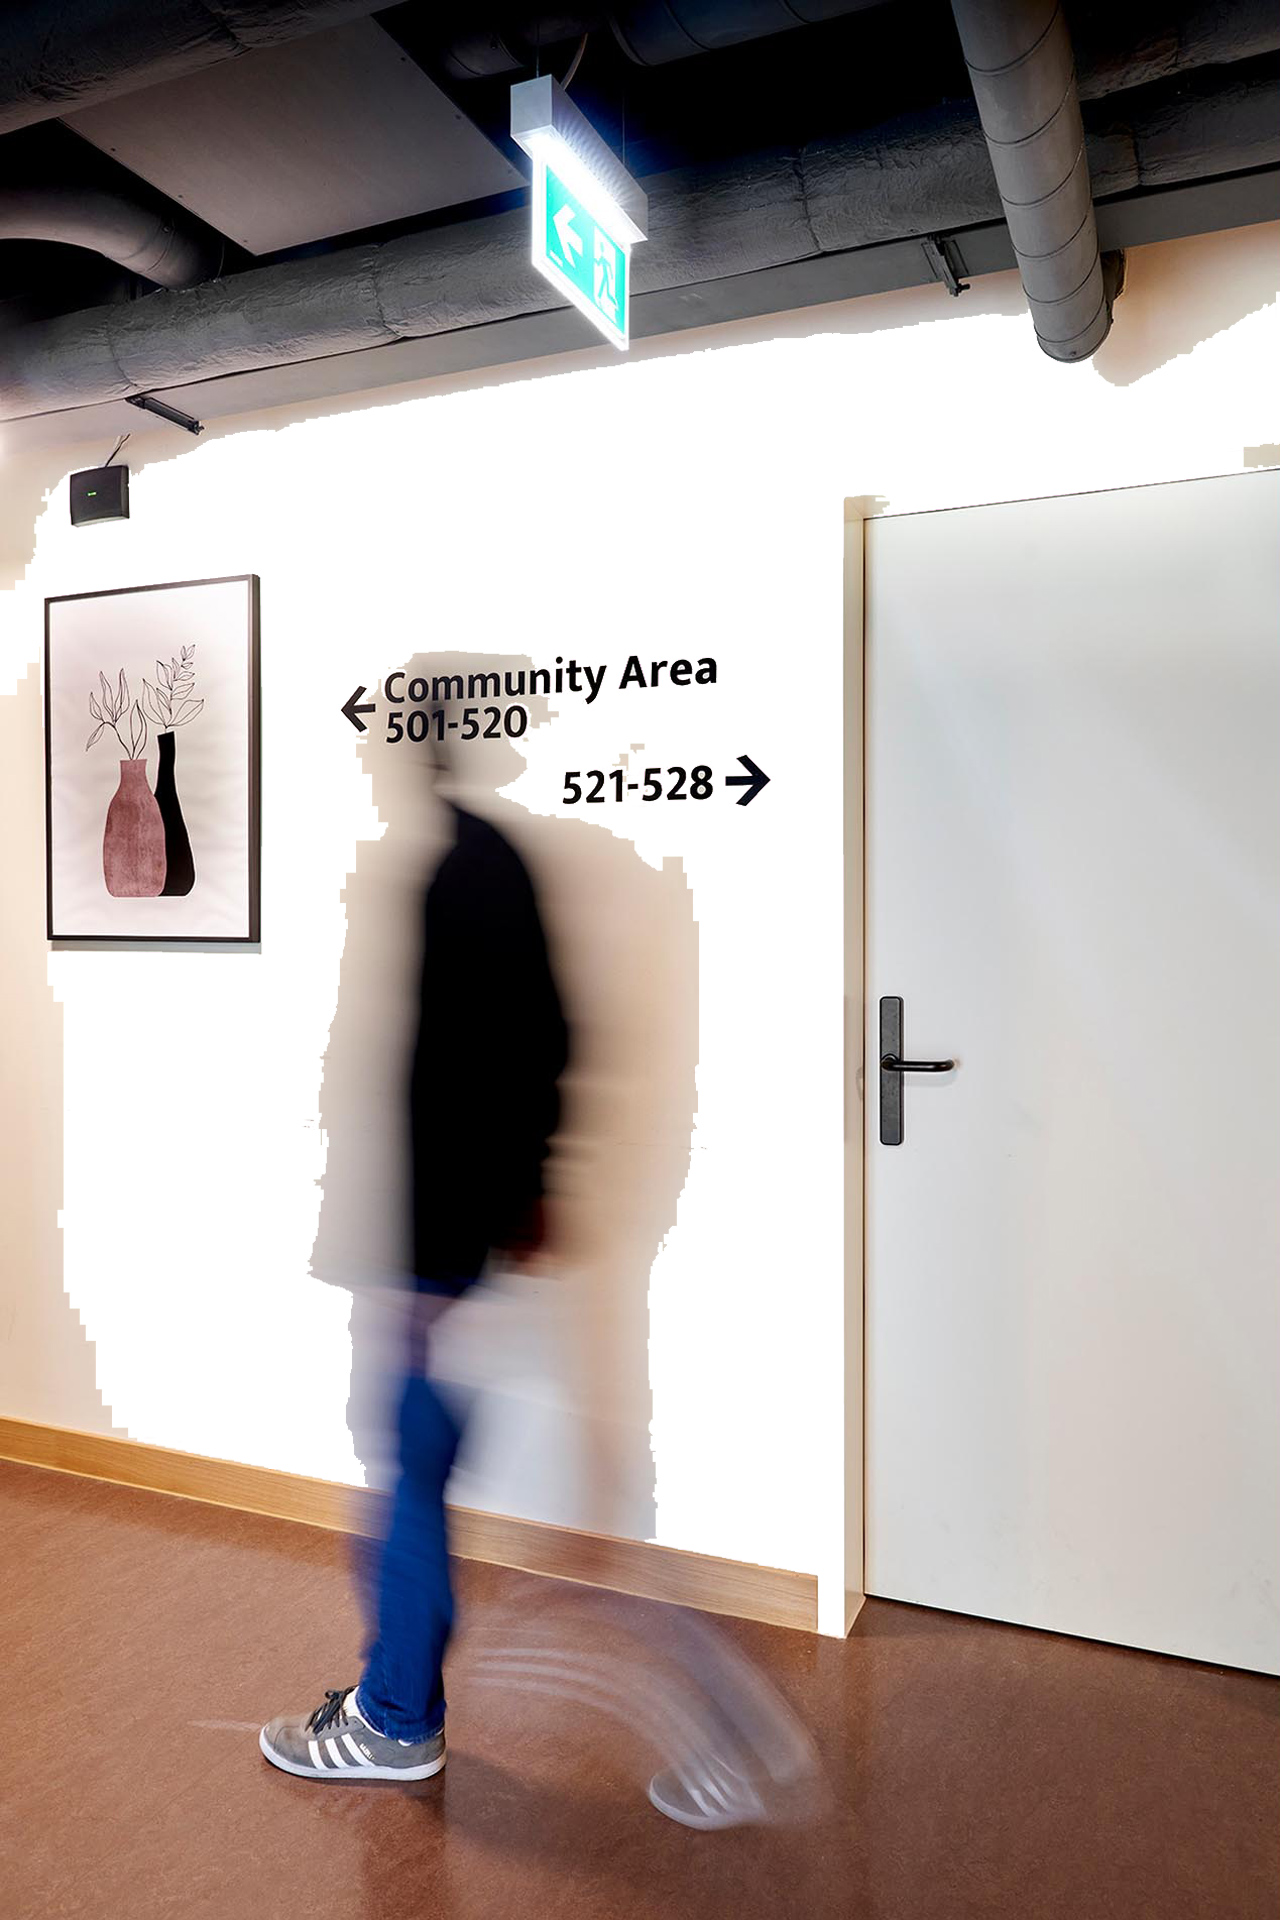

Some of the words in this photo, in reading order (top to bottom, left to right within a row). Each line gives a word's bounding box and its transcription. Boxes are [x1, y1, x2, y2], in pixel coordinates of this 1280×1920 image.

[385, 656, 607, 704] Community
[618, 655, 718, 689] Area
[385, 705, 528, 743] 501-520
[562, 765, 714, 804] 521-528
